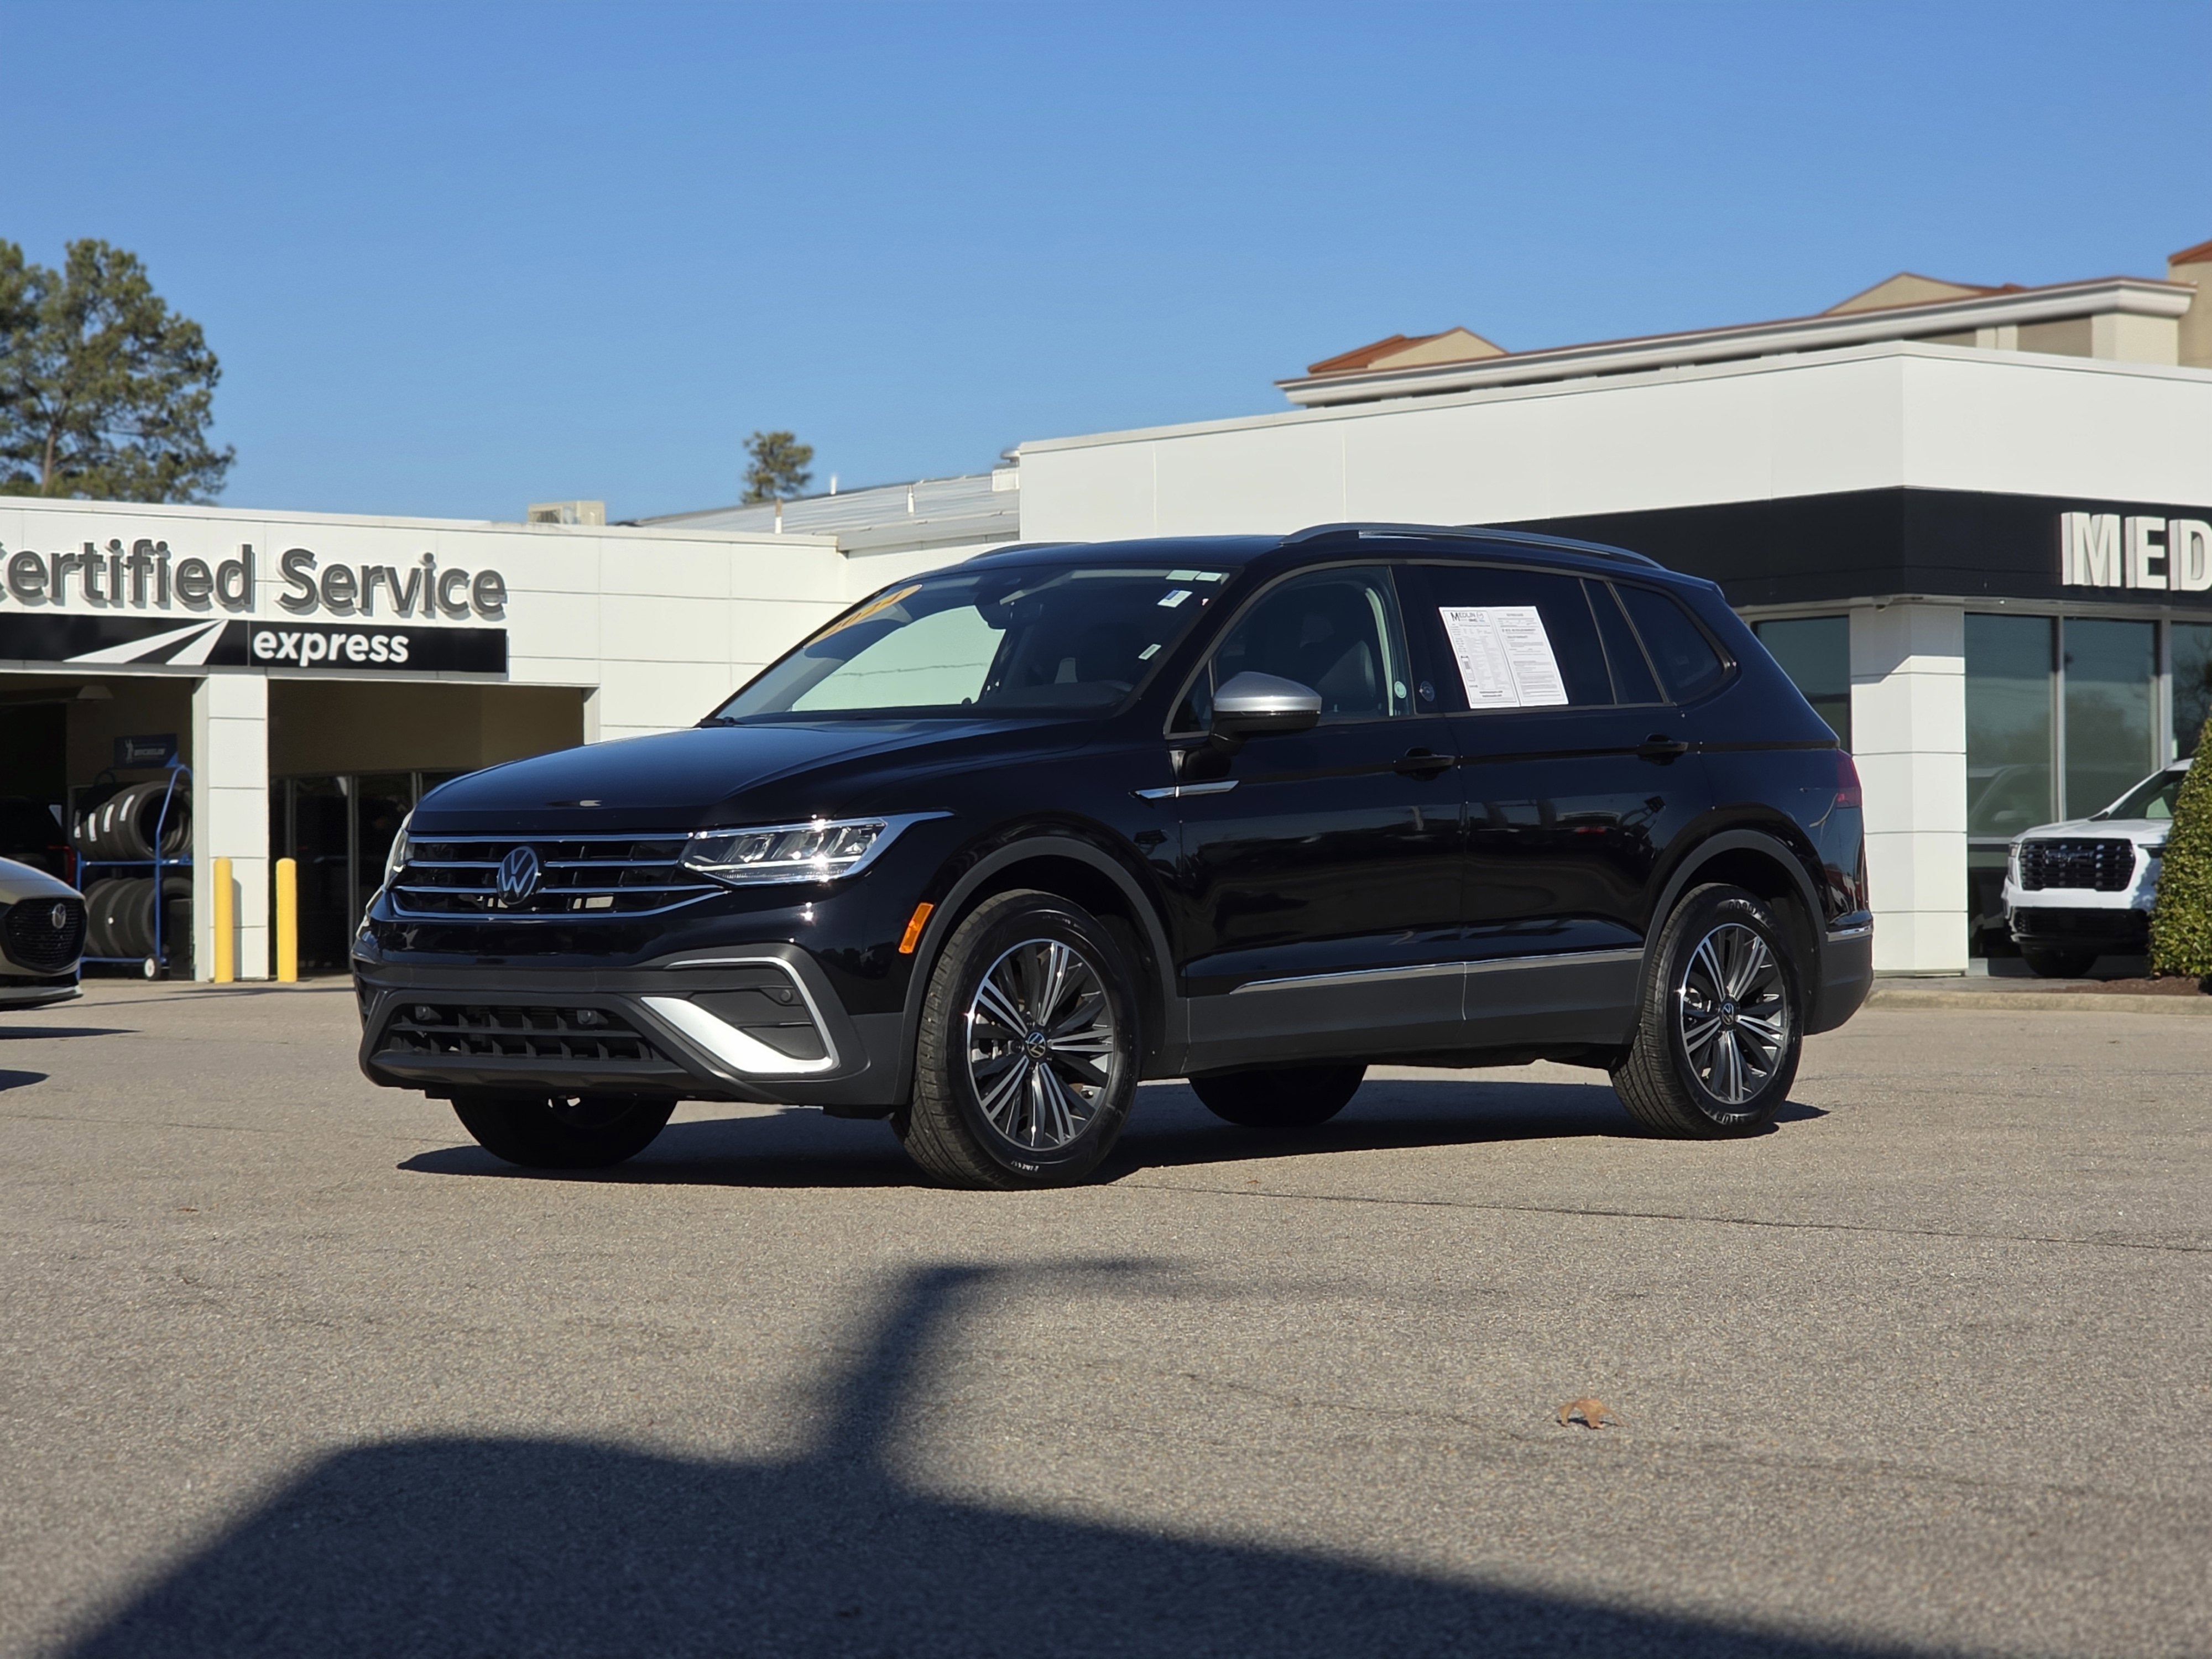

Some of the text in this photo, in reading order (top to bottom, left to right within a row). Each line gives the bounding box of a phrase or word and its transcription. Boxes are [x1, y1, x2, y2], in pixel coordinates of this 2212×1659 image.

[0, 539, 506, 614] ertified Service
[2062, 512, 2212, 591] MED
[253, 631, 409, 667] express
